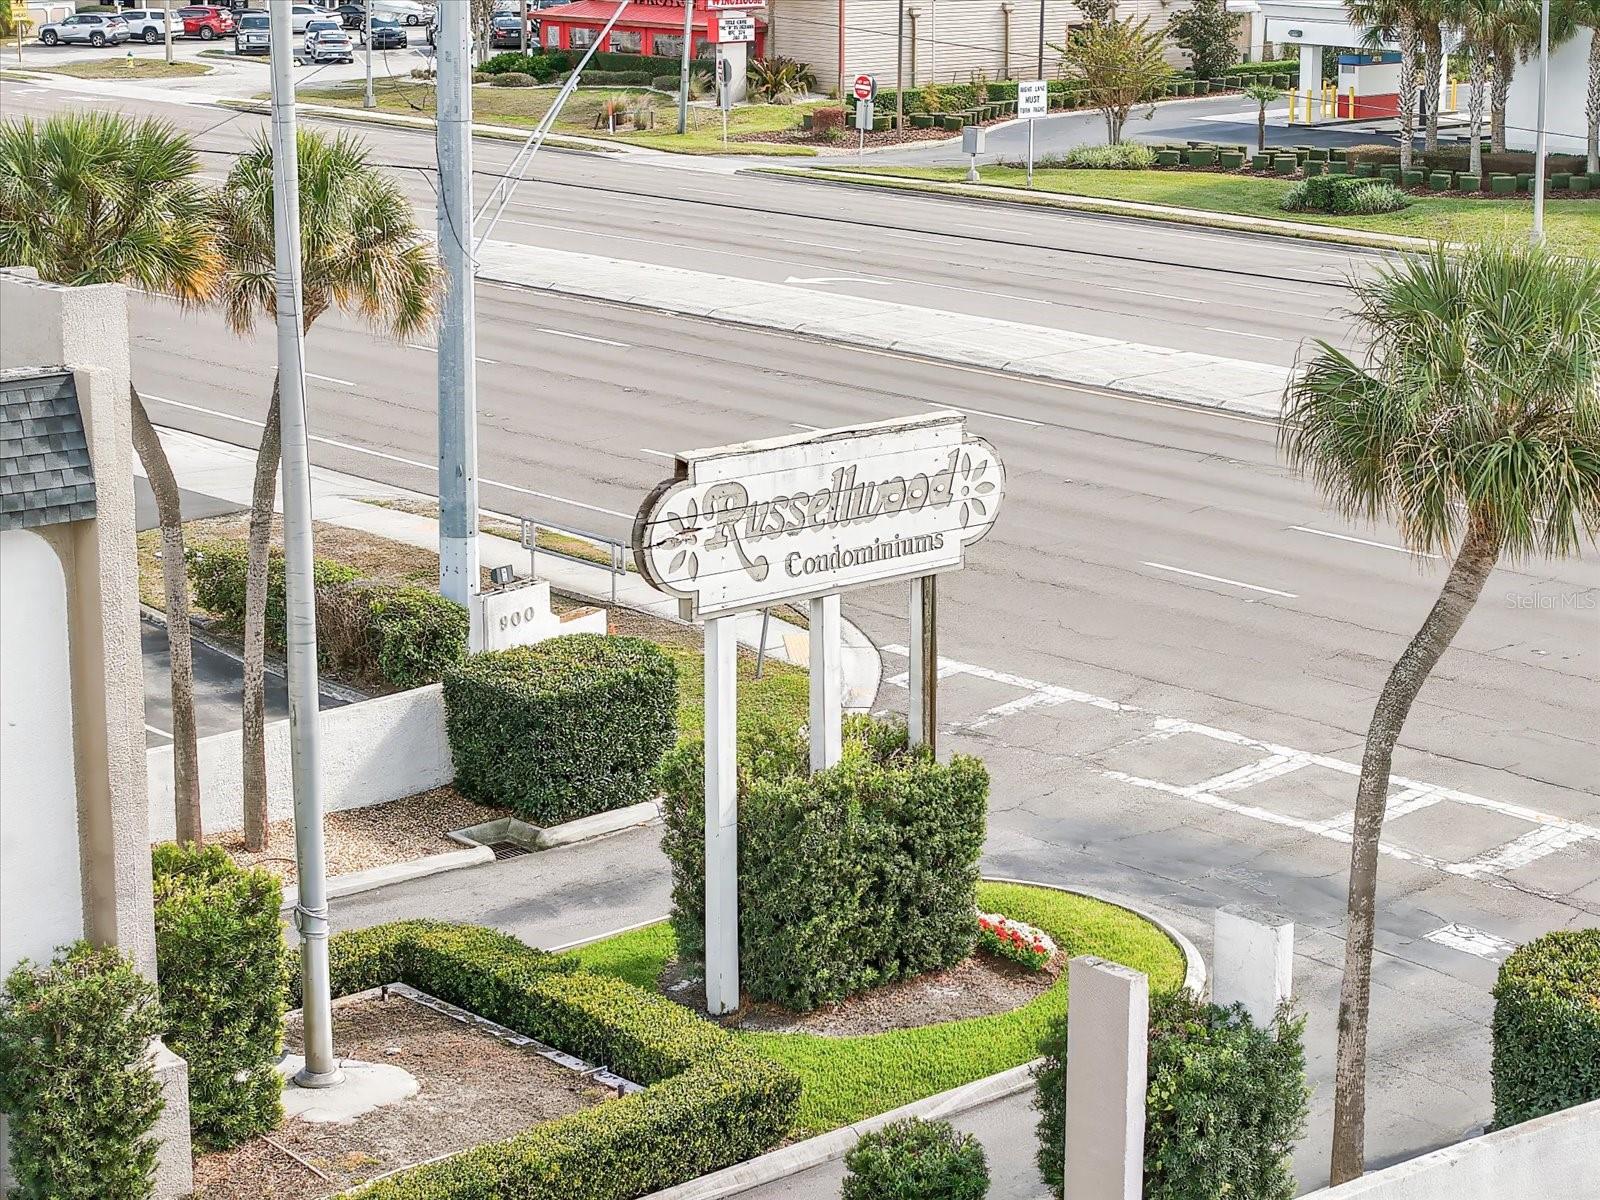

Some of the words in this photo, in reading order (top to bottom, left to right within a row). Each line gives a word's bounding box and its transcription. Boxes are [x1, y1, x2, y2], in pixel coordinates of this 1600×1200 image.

[1025, 95, 1040, 104] MUST
[701, 447, 960, 582] Russellwood
[785, 532, 944, 577] Condominiums
